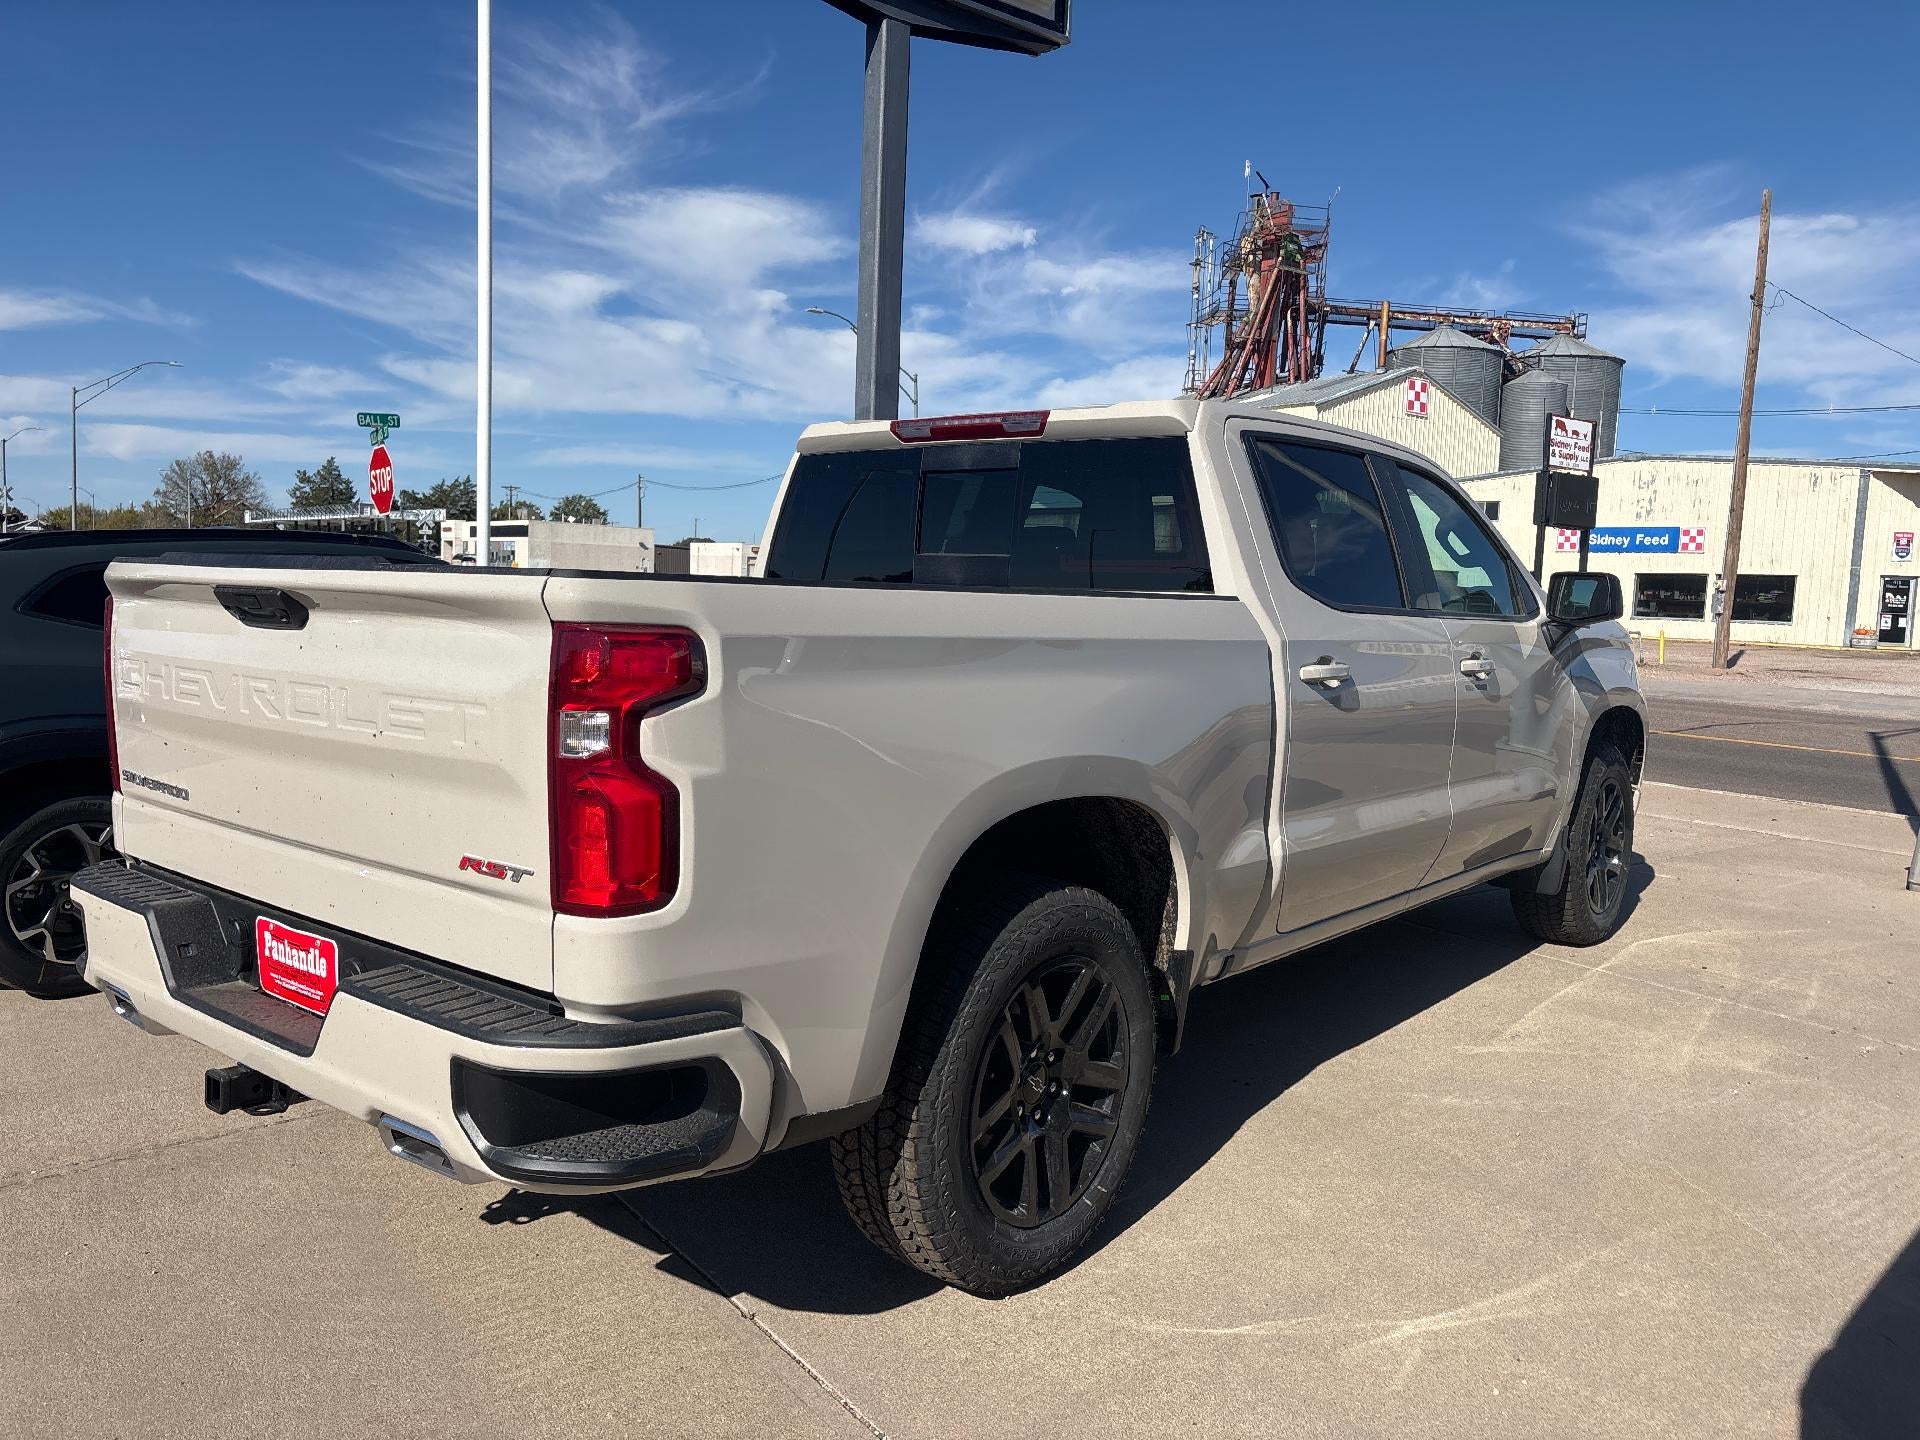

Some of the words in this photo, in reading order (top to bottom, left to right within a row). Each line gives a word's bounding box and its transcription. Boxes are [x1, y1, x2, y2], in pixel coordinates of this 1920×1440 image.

[358, 415, 383, 426] BALL
[387, 416, 398, 426] ST
[1550, 438, 1573, 451] Sidney
[1573, 441, 1590, 453] Feed
[1550, 448, 1557, 458] &
[370, 466, 392, 495] STOP
[1588, 533, 1630, 548] Sidney
[1635, 533, 1669, 546] Feed
[117, 656, 488, 746] CHEVROLET
[121, 769, 190, 801] SILVERADO
[458, 854, 535, 883] RST
[263, 930, 327, 979] Panhandle
